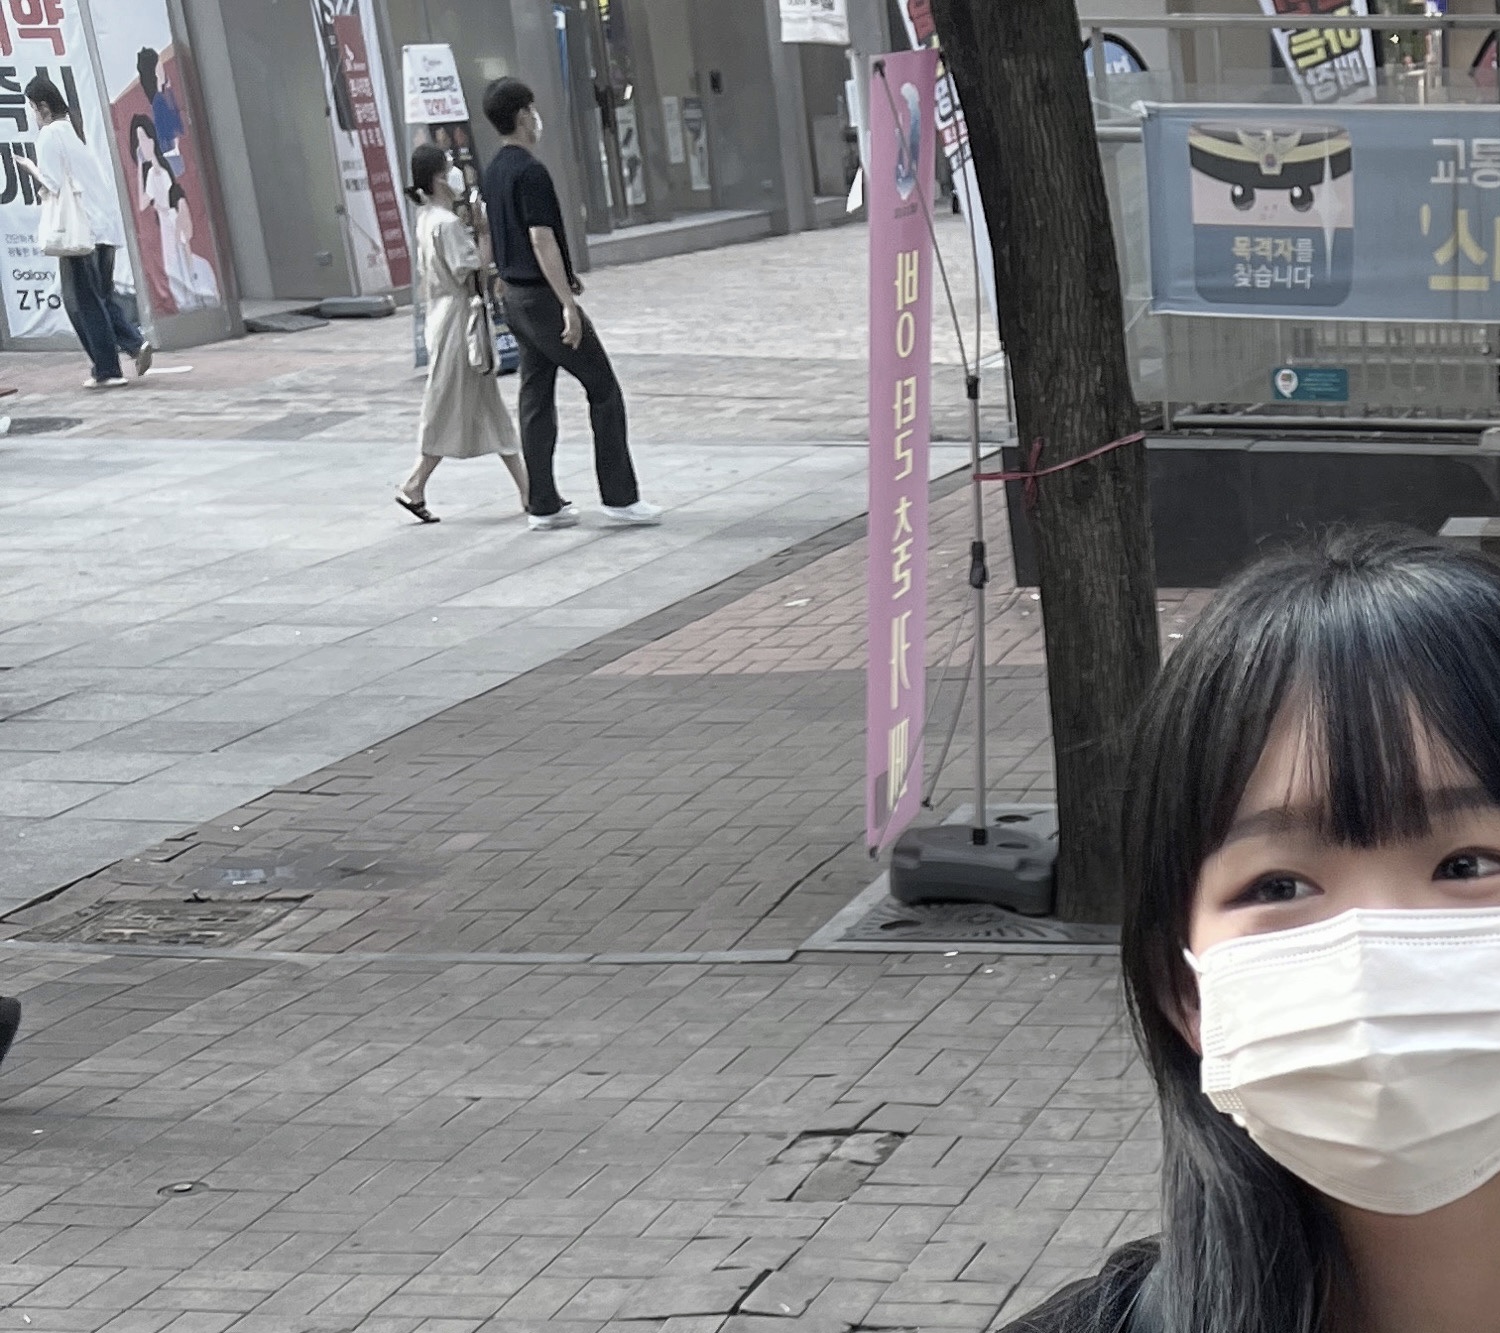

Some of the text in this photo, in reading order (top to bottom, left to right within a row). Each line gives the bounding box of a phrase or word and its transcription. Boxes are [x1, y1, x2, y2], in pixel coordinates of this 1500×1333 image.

[1232, 236, 1316, 262] 목격자를
[12, 269, 56, 285] Galaxy
[1233, 263, 1315, 289] 찾습니다
[16, 289, 61, 310] Z Fo
